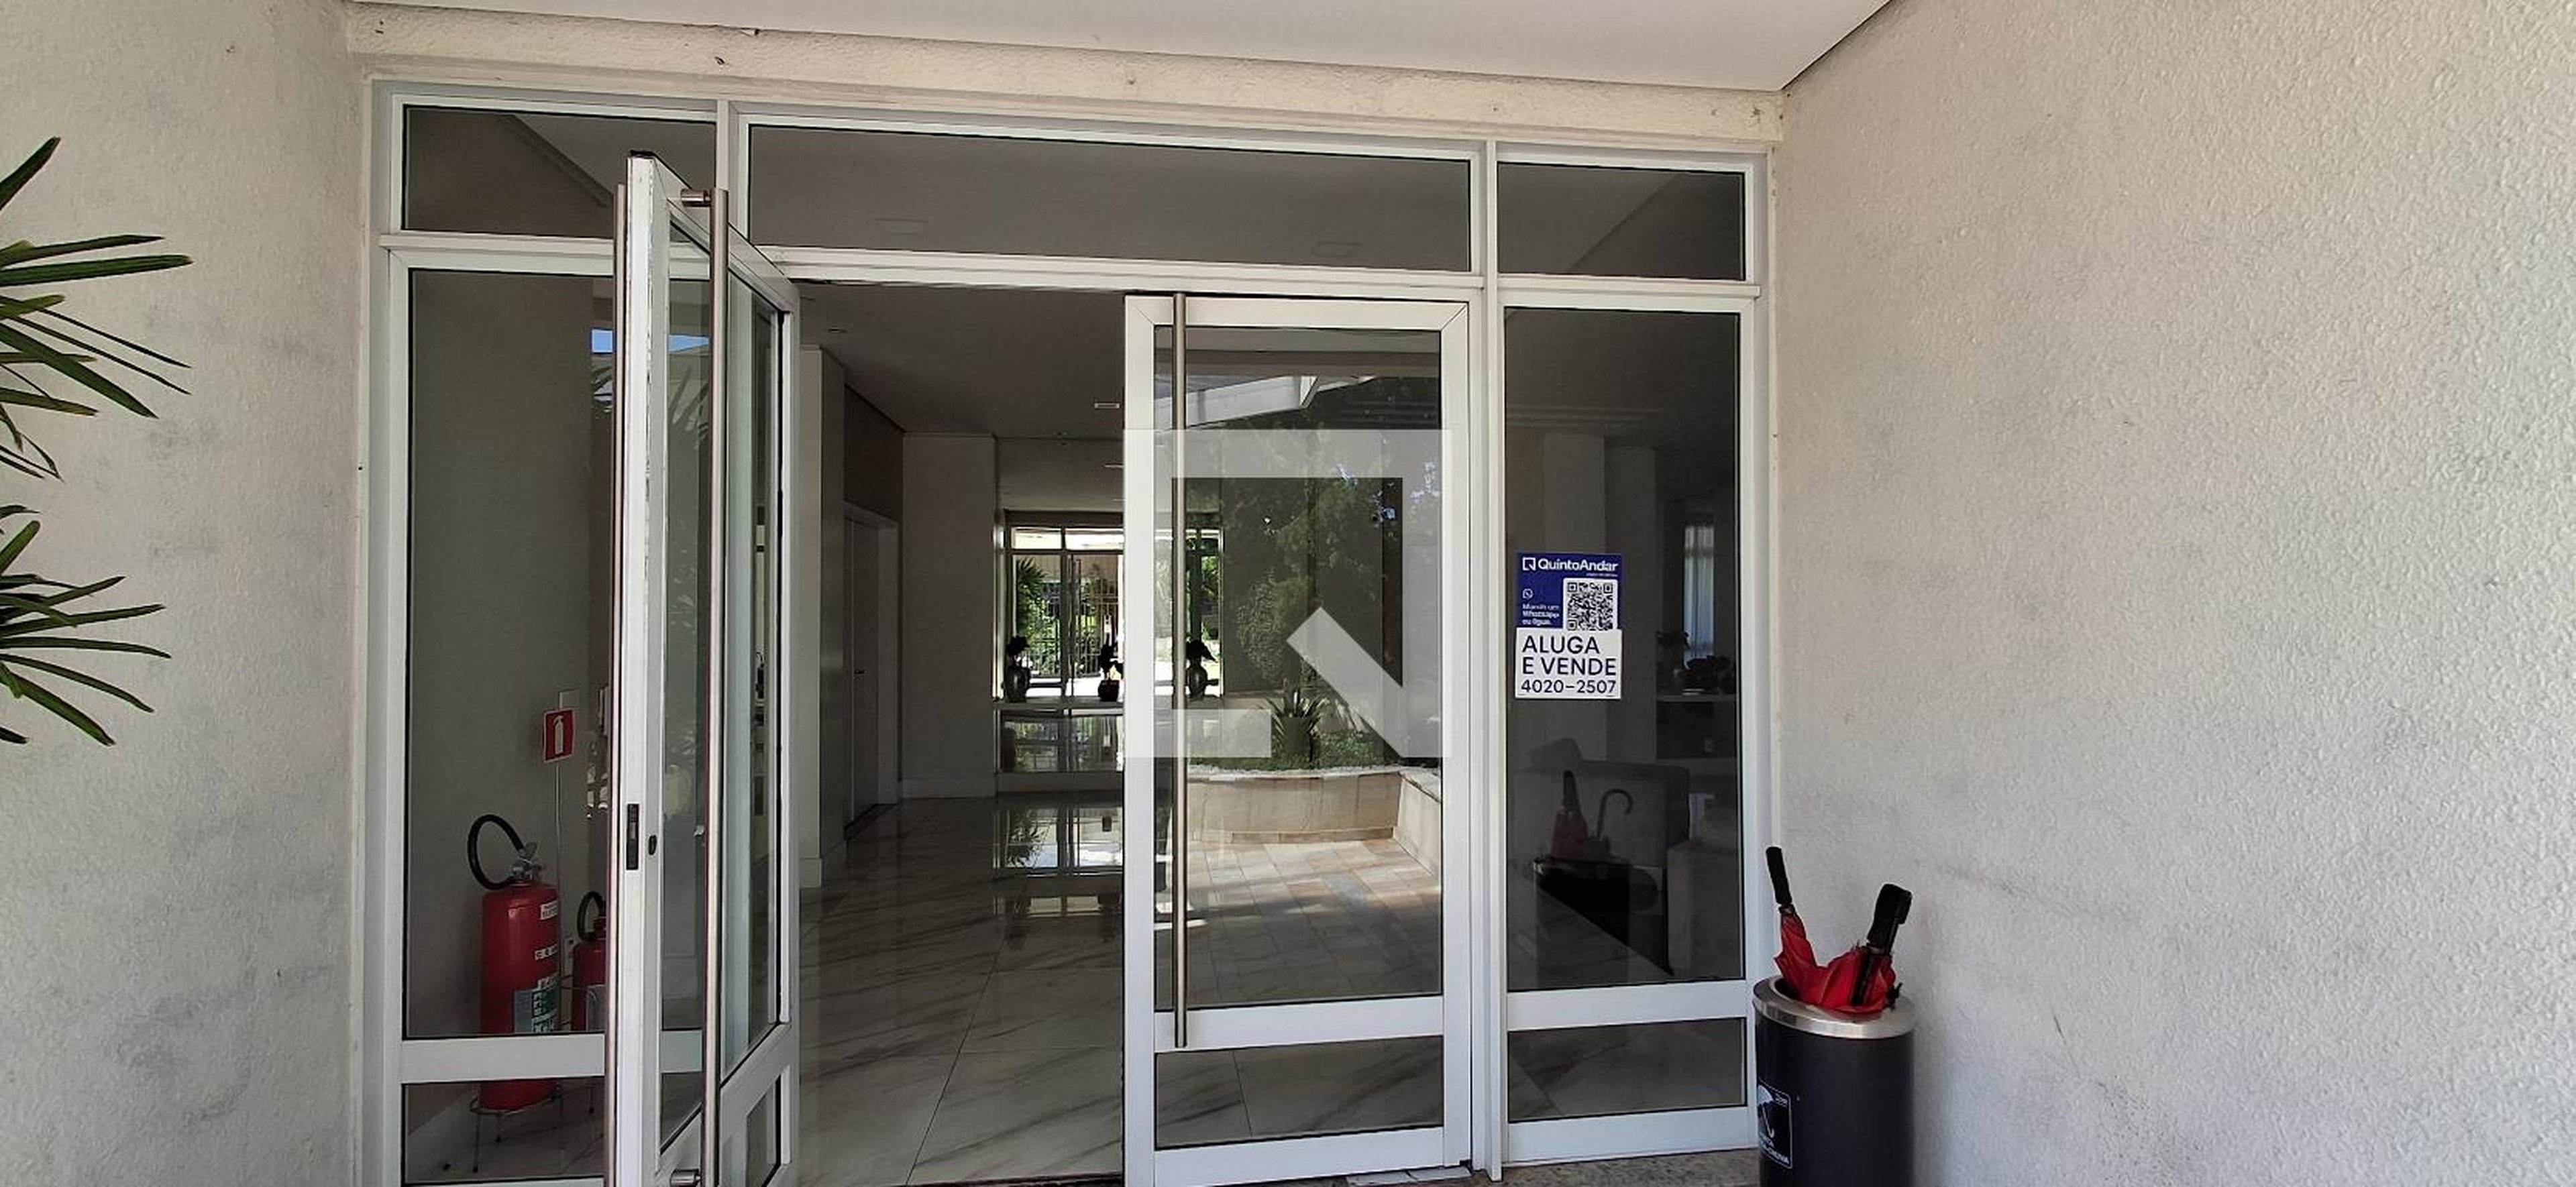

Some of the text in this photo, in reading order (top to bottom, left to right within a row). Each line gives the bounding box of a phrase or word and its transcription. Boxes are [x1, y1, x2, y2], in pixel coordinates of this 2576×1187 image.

[1538, 558, 1618, 571] QuintoAndar
[1522, 635, 1600, 654] ALUGA
[1523, 657, 1617, 676] E VENDE
[1521, 679, 1617, 693] 4020-2507
